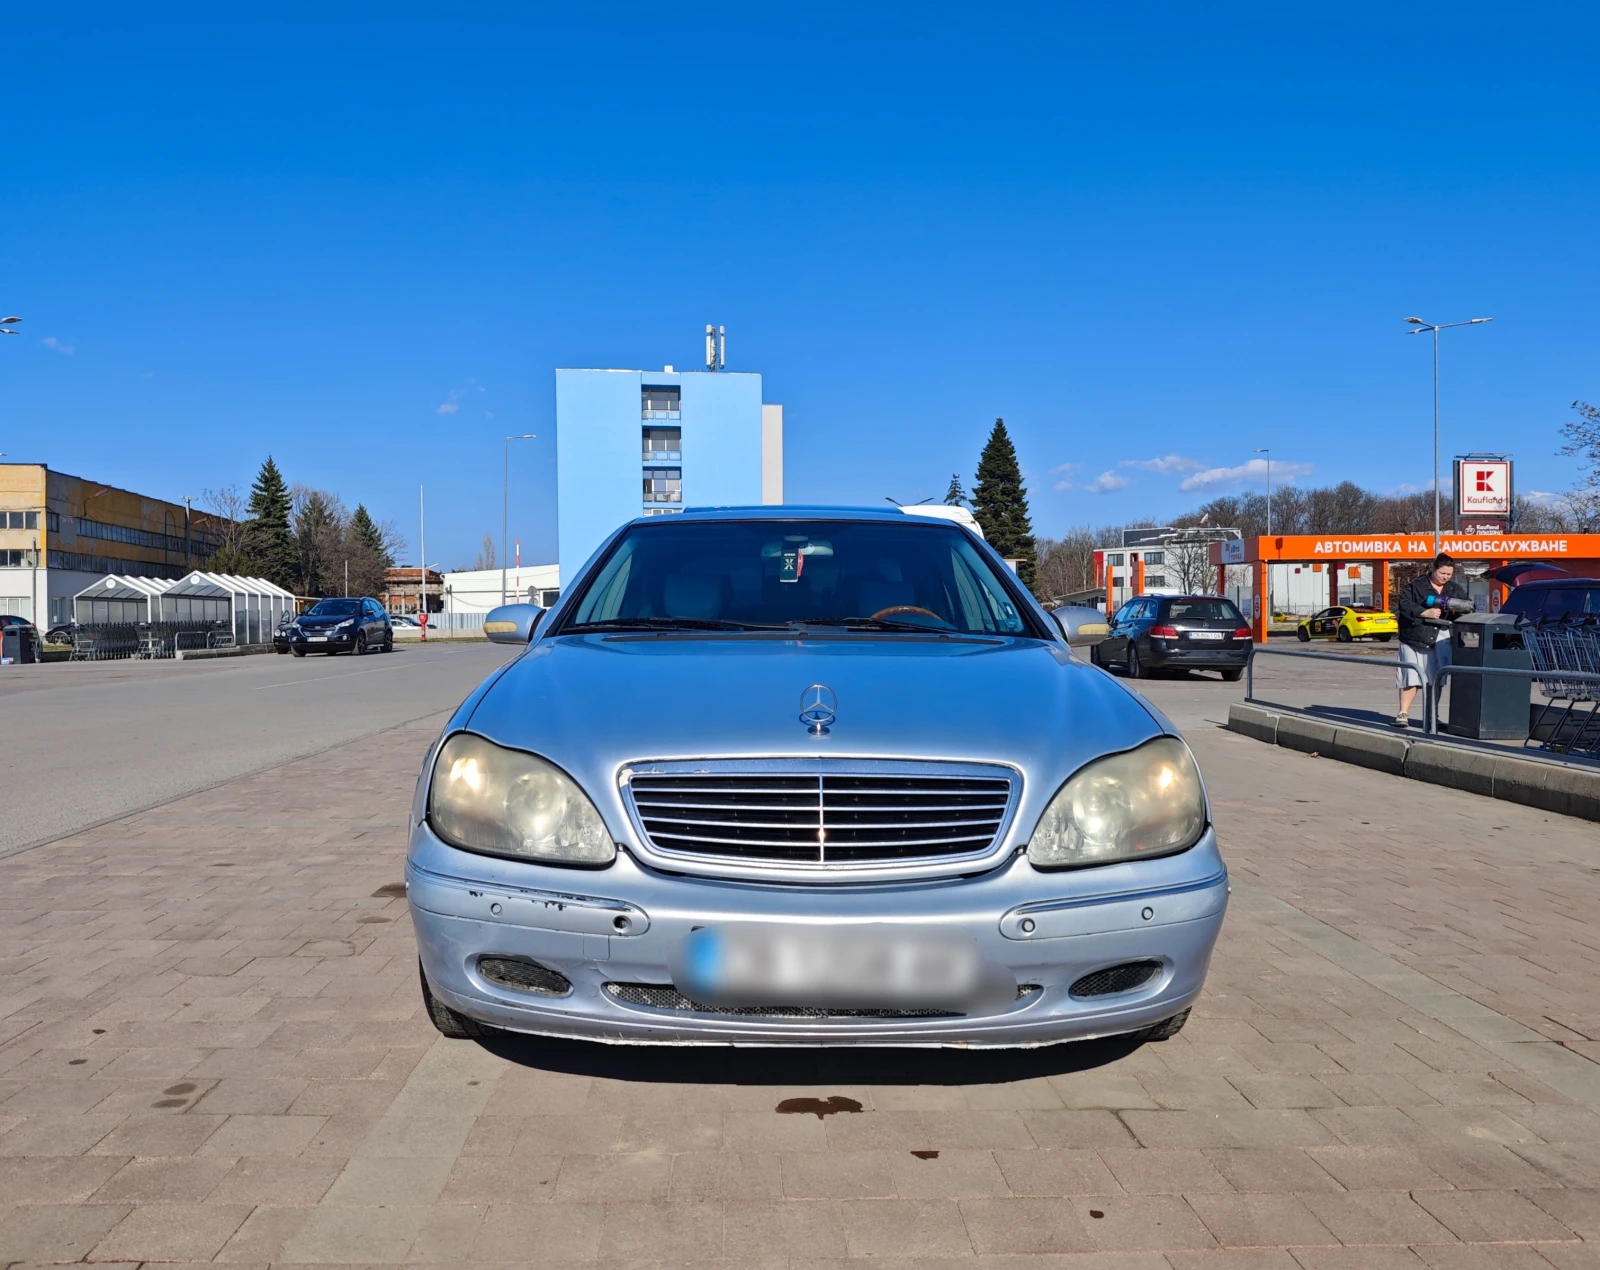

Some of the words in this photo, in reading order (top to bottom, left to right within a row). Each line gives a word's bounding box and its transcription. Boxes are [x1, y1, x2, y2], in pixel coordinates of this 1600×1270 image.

[1467, 496, 1503, 504] Kaufland
[1314, 541, 1402, 553] АВТОМИВКА
[1407, 541, 1428, 553] НА
